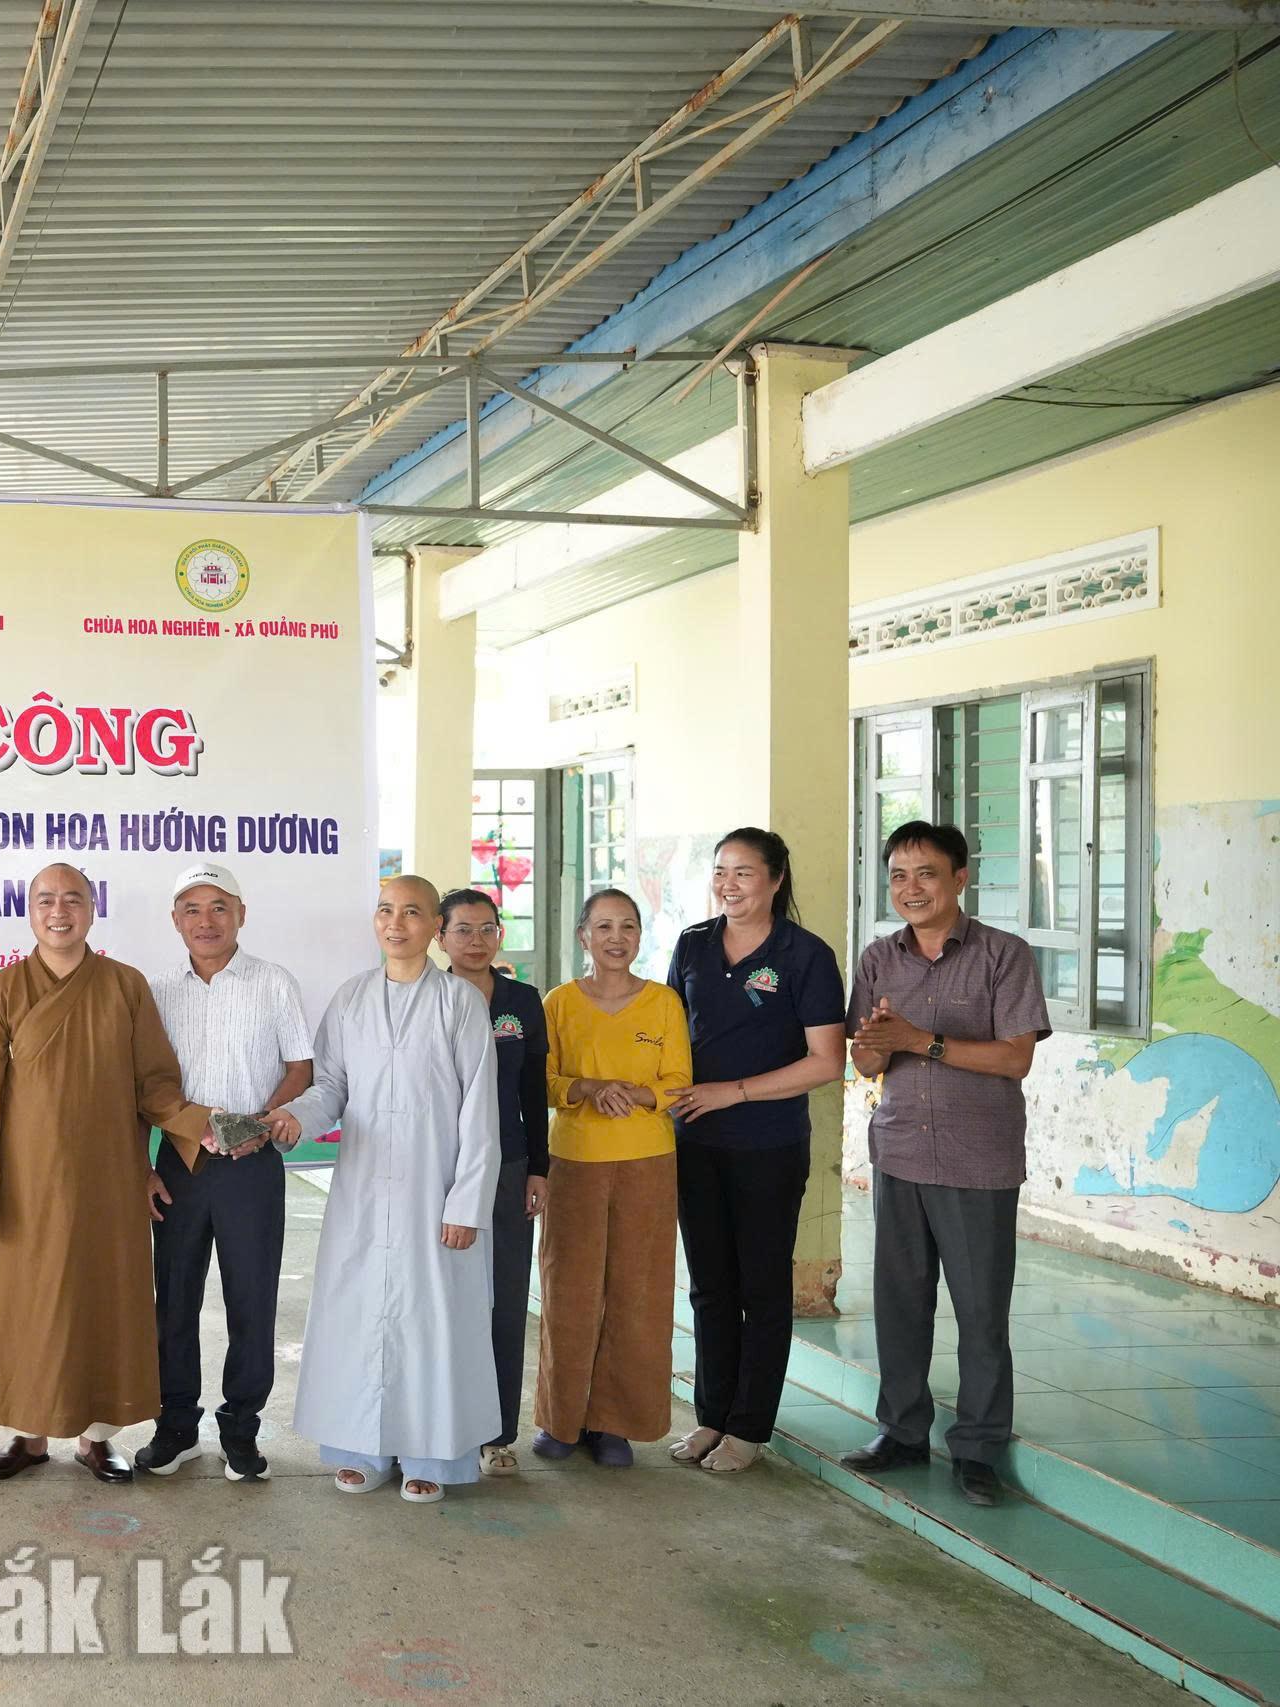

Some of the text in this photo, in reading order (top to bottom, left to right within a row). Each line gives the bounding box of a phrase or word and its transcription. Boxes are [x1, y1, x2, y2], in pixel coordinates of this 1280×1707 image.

[83, 615, 123, 635] CHÙA
[128, 618, 158, 636] HOA
[162, 617, 220, 638] NGHIÊM
[234, 619, 256, 638] XÃ
[259, 615, 308, 639] QUẢNG
[310, 619, 339, 640] PHÚ
[46, 812, 110, 851] HOA
[120, 806, 227, 853] HƯỚNG
[237, 813, 339, 855] DƯƠNG
[634, 1031, 665, 1047] Smile
